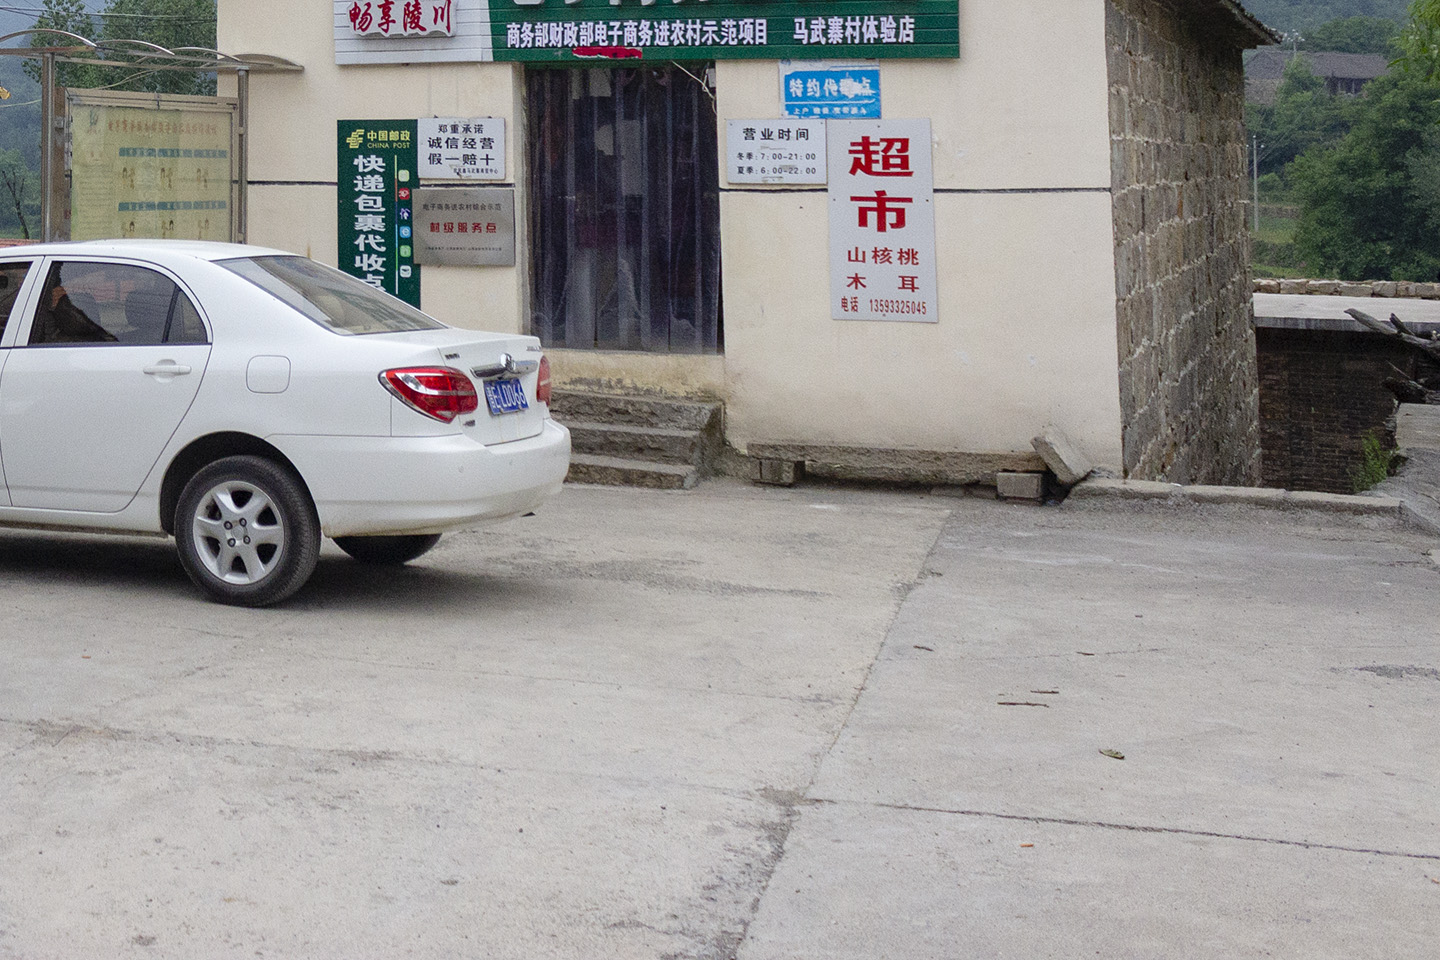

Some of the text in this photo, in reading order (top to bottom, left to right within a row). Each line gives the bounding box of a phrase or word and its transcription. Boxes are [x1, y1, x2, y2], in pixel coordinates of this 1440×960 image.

[506, 15, 916, 49] 商务部财政部电子商务进农村示范项目 马武寨村体验店
[367, 130, 411, 141] 中国邮政
[438, 123, 484, 134] 郑重承诺
[742, 127, 810, 141] 营业时间
[427, 136, 495, 149] 诚信经营
[427, 153, 495, 166] 假一赔十
[848, 135, 915, 233] 超市
[847, 246, 920, 266] 山核桃
[841, 296, 927, 315] 电话 13593325045
